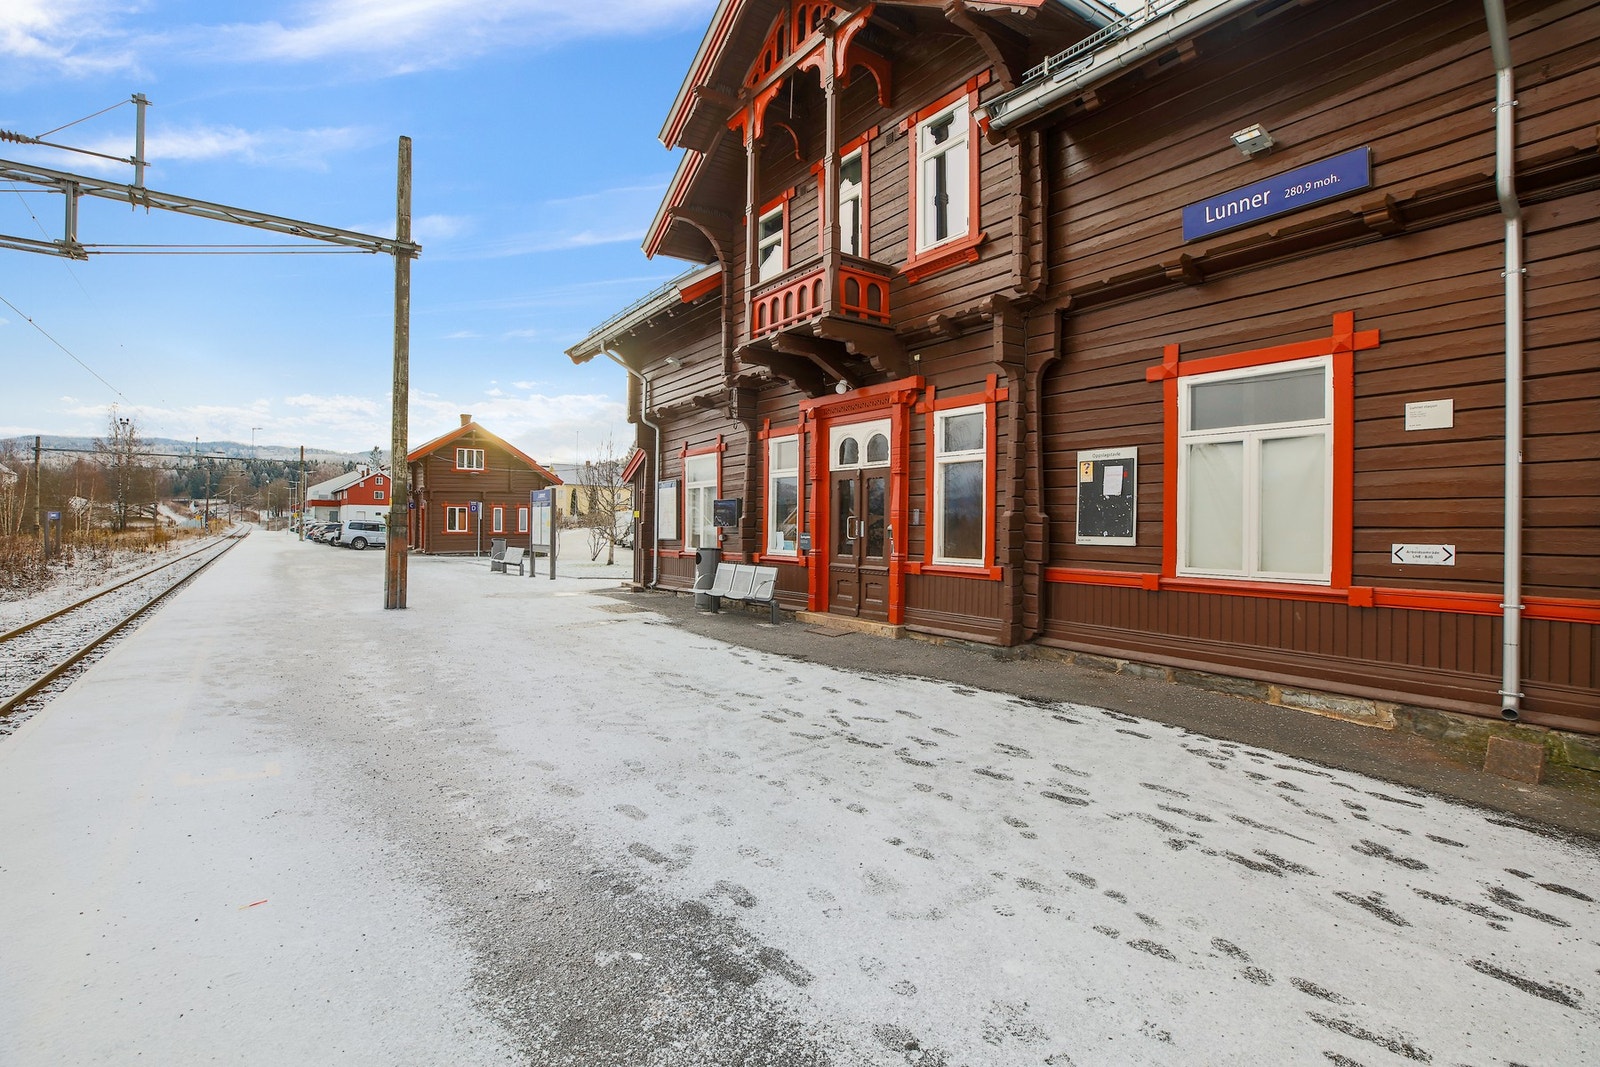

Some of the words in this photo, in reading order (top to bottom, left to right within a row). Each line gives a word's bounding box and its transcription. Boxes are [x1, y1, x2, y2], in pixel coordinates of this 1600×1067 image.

[1205, 190, 1271, 224] Lunner
[1284, 181, 1312, 199] 280,9
[1313, 173, 1341, 190] moh.
